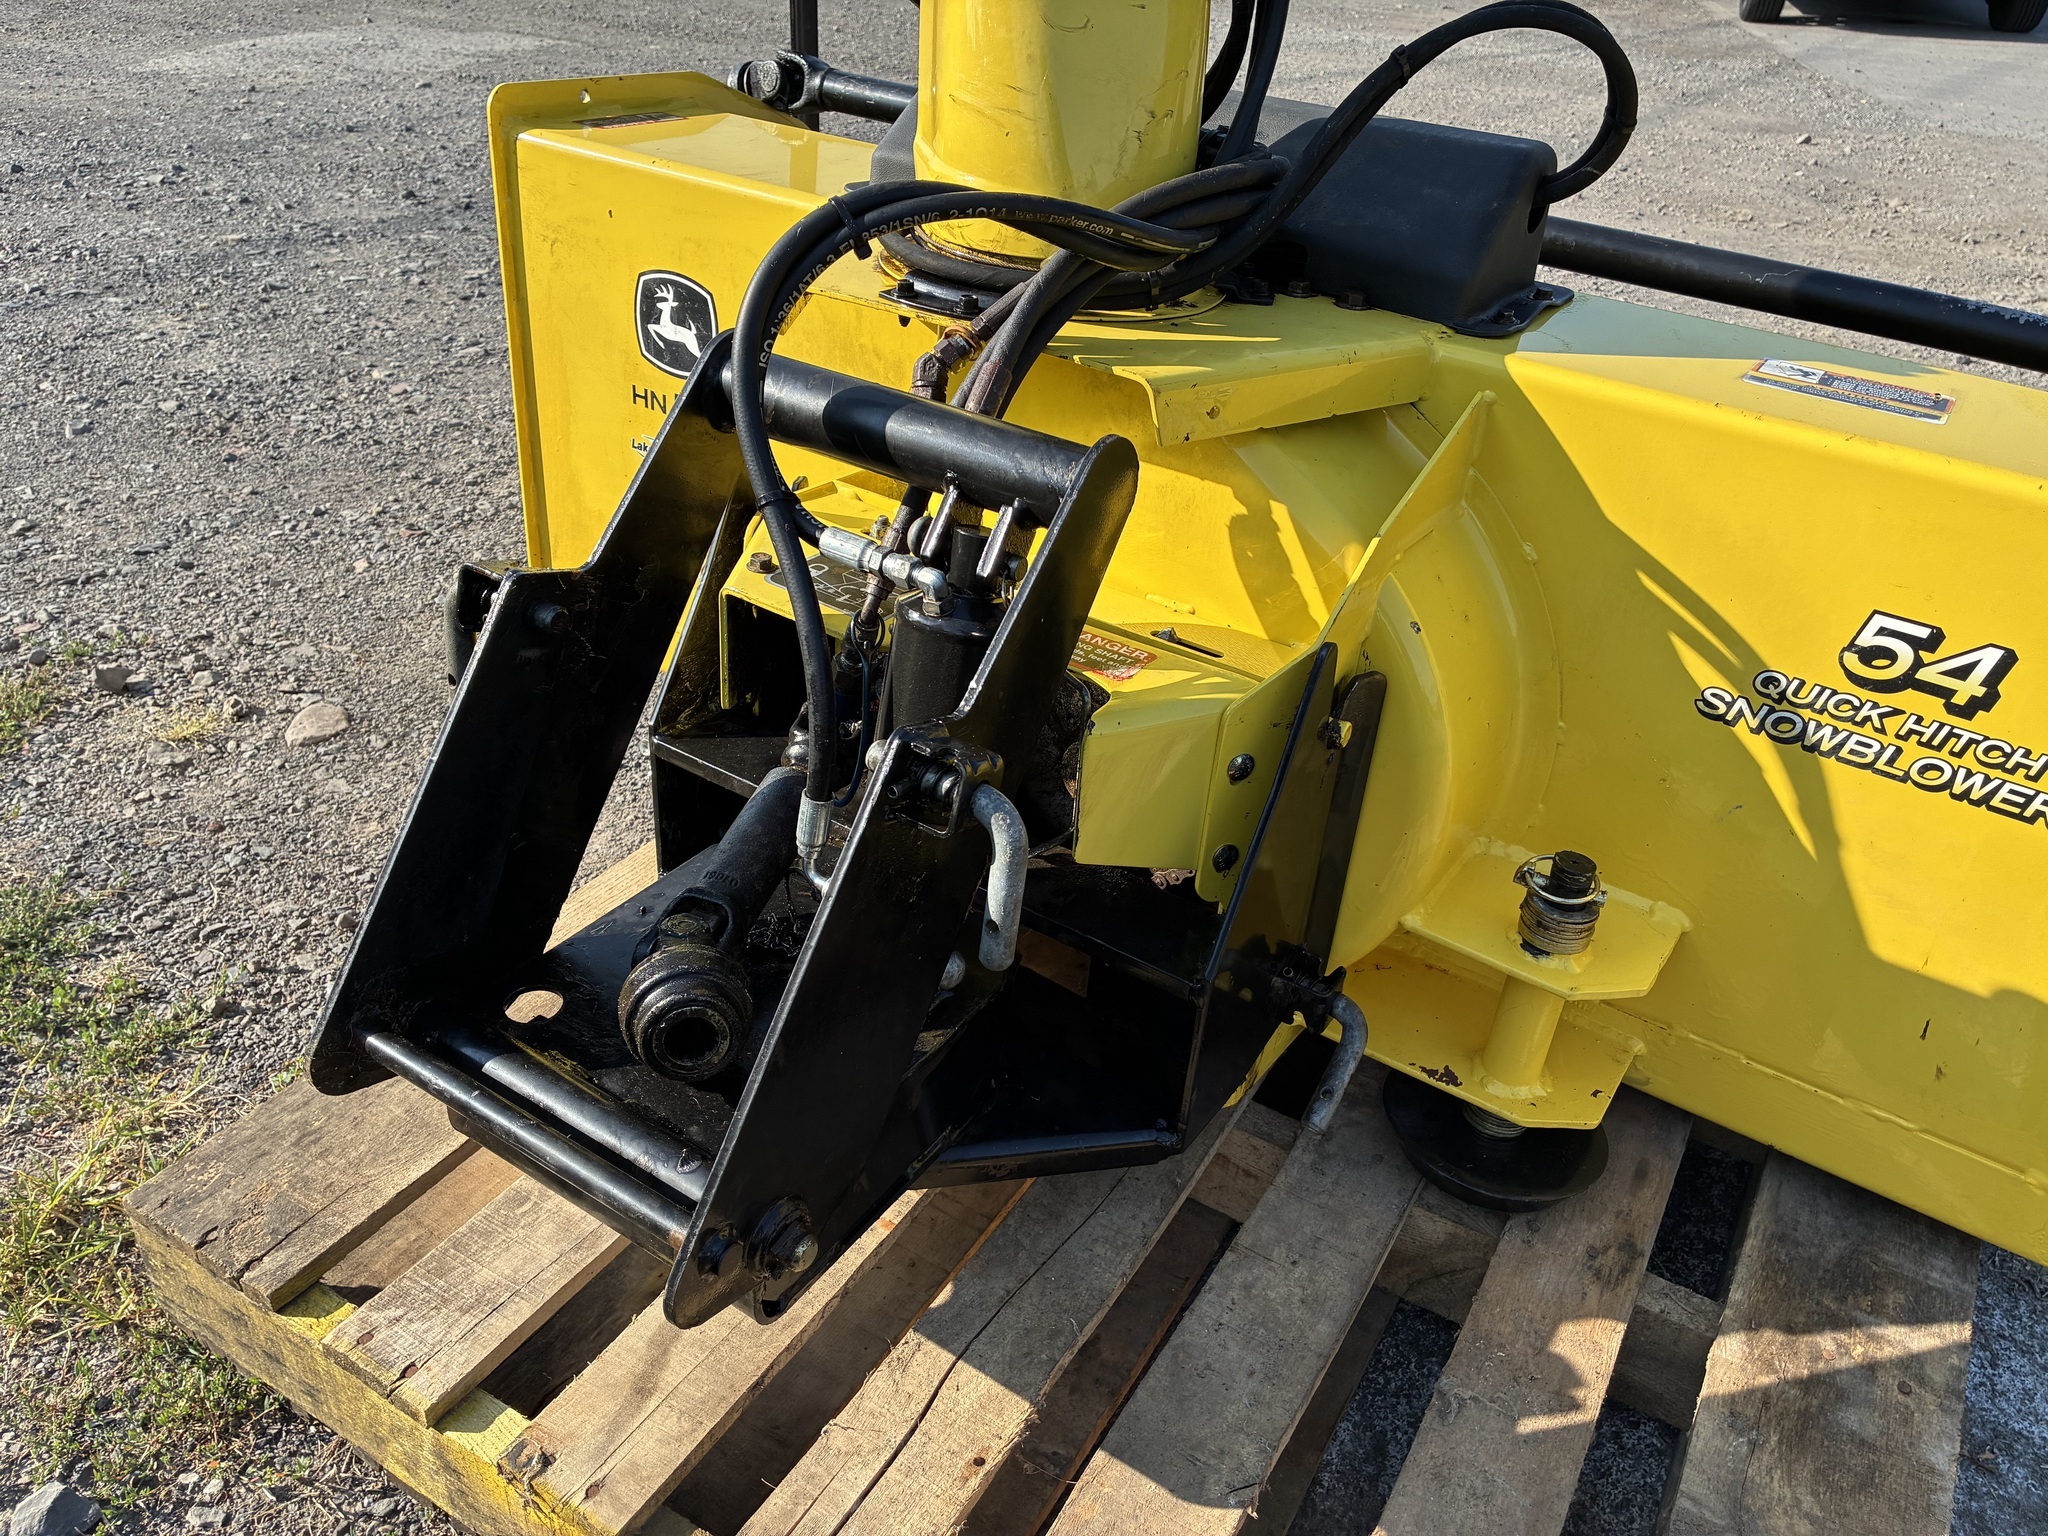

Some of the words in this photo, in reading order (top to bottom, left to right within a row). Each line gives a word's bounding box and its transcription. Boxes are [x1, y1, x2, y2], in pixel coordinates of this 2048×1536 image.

[758, 339, 774, 367] ISO
[1014, 209, 1114, 236] www.parker.com
[632, 385, 667, 414] HN
[632, 438, 651, 452] Lak
[1076, 642, 1093, 651] NG
[1094, 648, 1134, 664] SHAFT
[1080, 633, 1148, 660] ANGER
[1088, 653, 1107, 664] feet
[1838, 608, 2020, 721] 54
[1751, 669, 1907, 738] QUICK
[1898, 713, 2048, 783] HITCH
[1694, 687, 2048, 831] SNOWBLOWER
